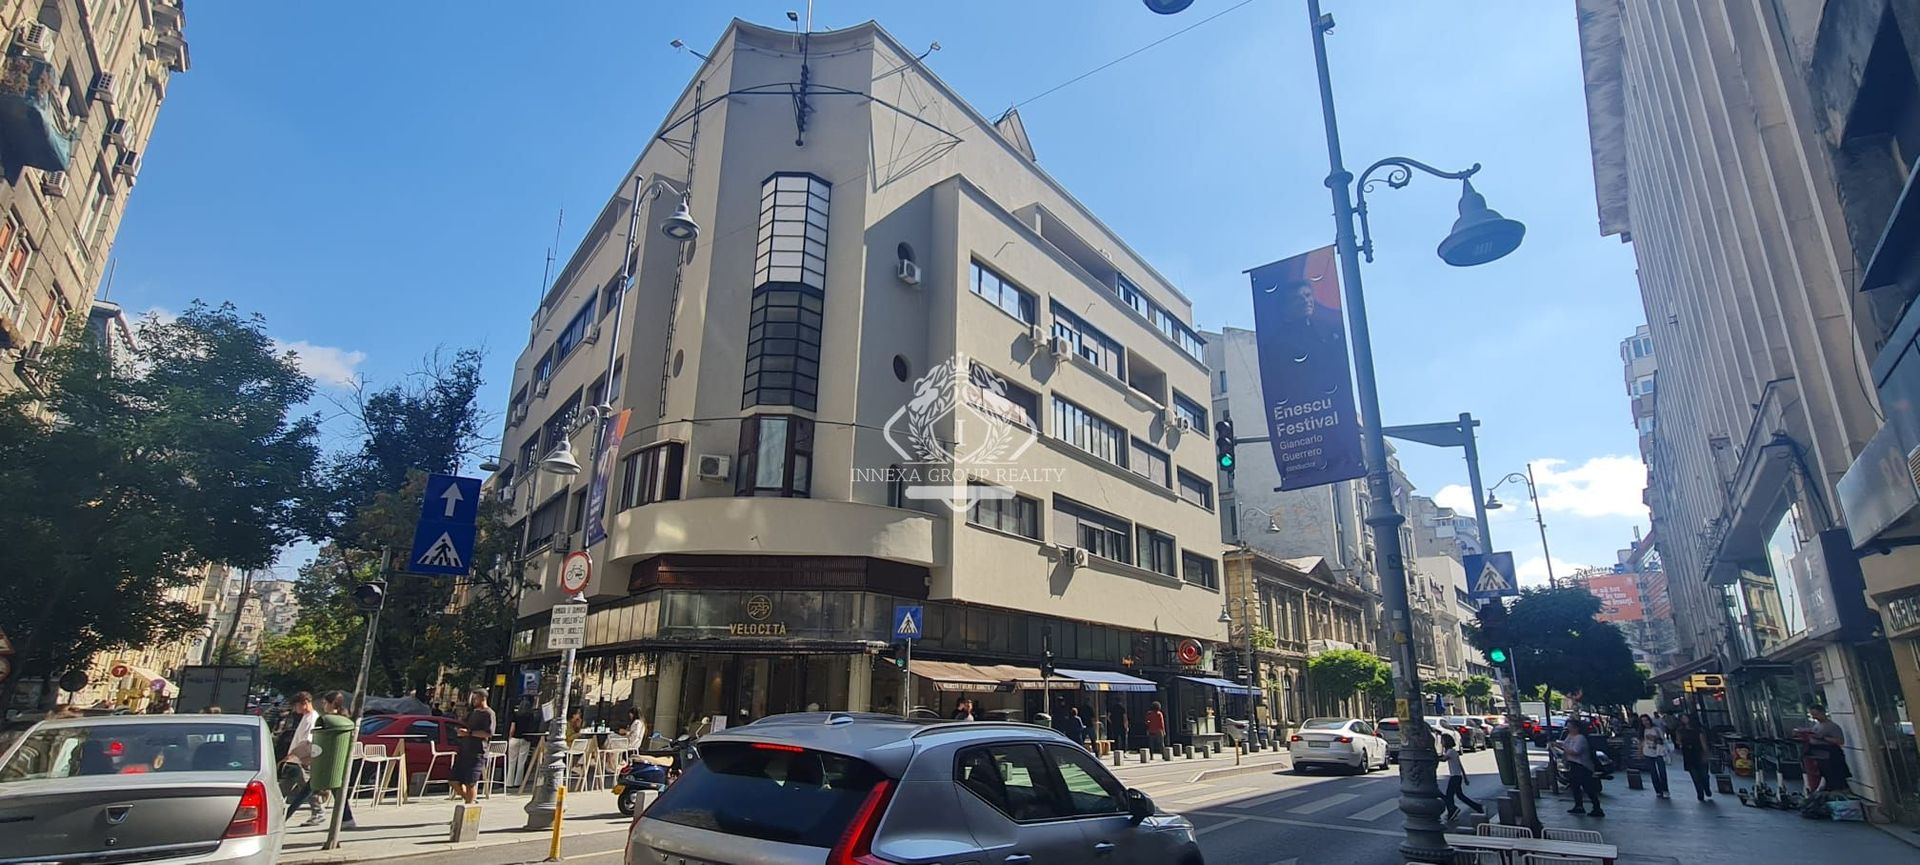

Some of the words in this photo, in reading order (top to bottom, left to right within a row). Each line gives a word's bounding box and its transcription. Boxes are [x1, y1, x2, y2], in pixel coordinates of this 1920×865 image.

[1274, 398, 1332, 420] Enescu
[1276, 411, 1339, 438] Festival
[1280, 434, 1323, 450] Giancarlo
[1282, 447, 1322, 462] Guerrero
